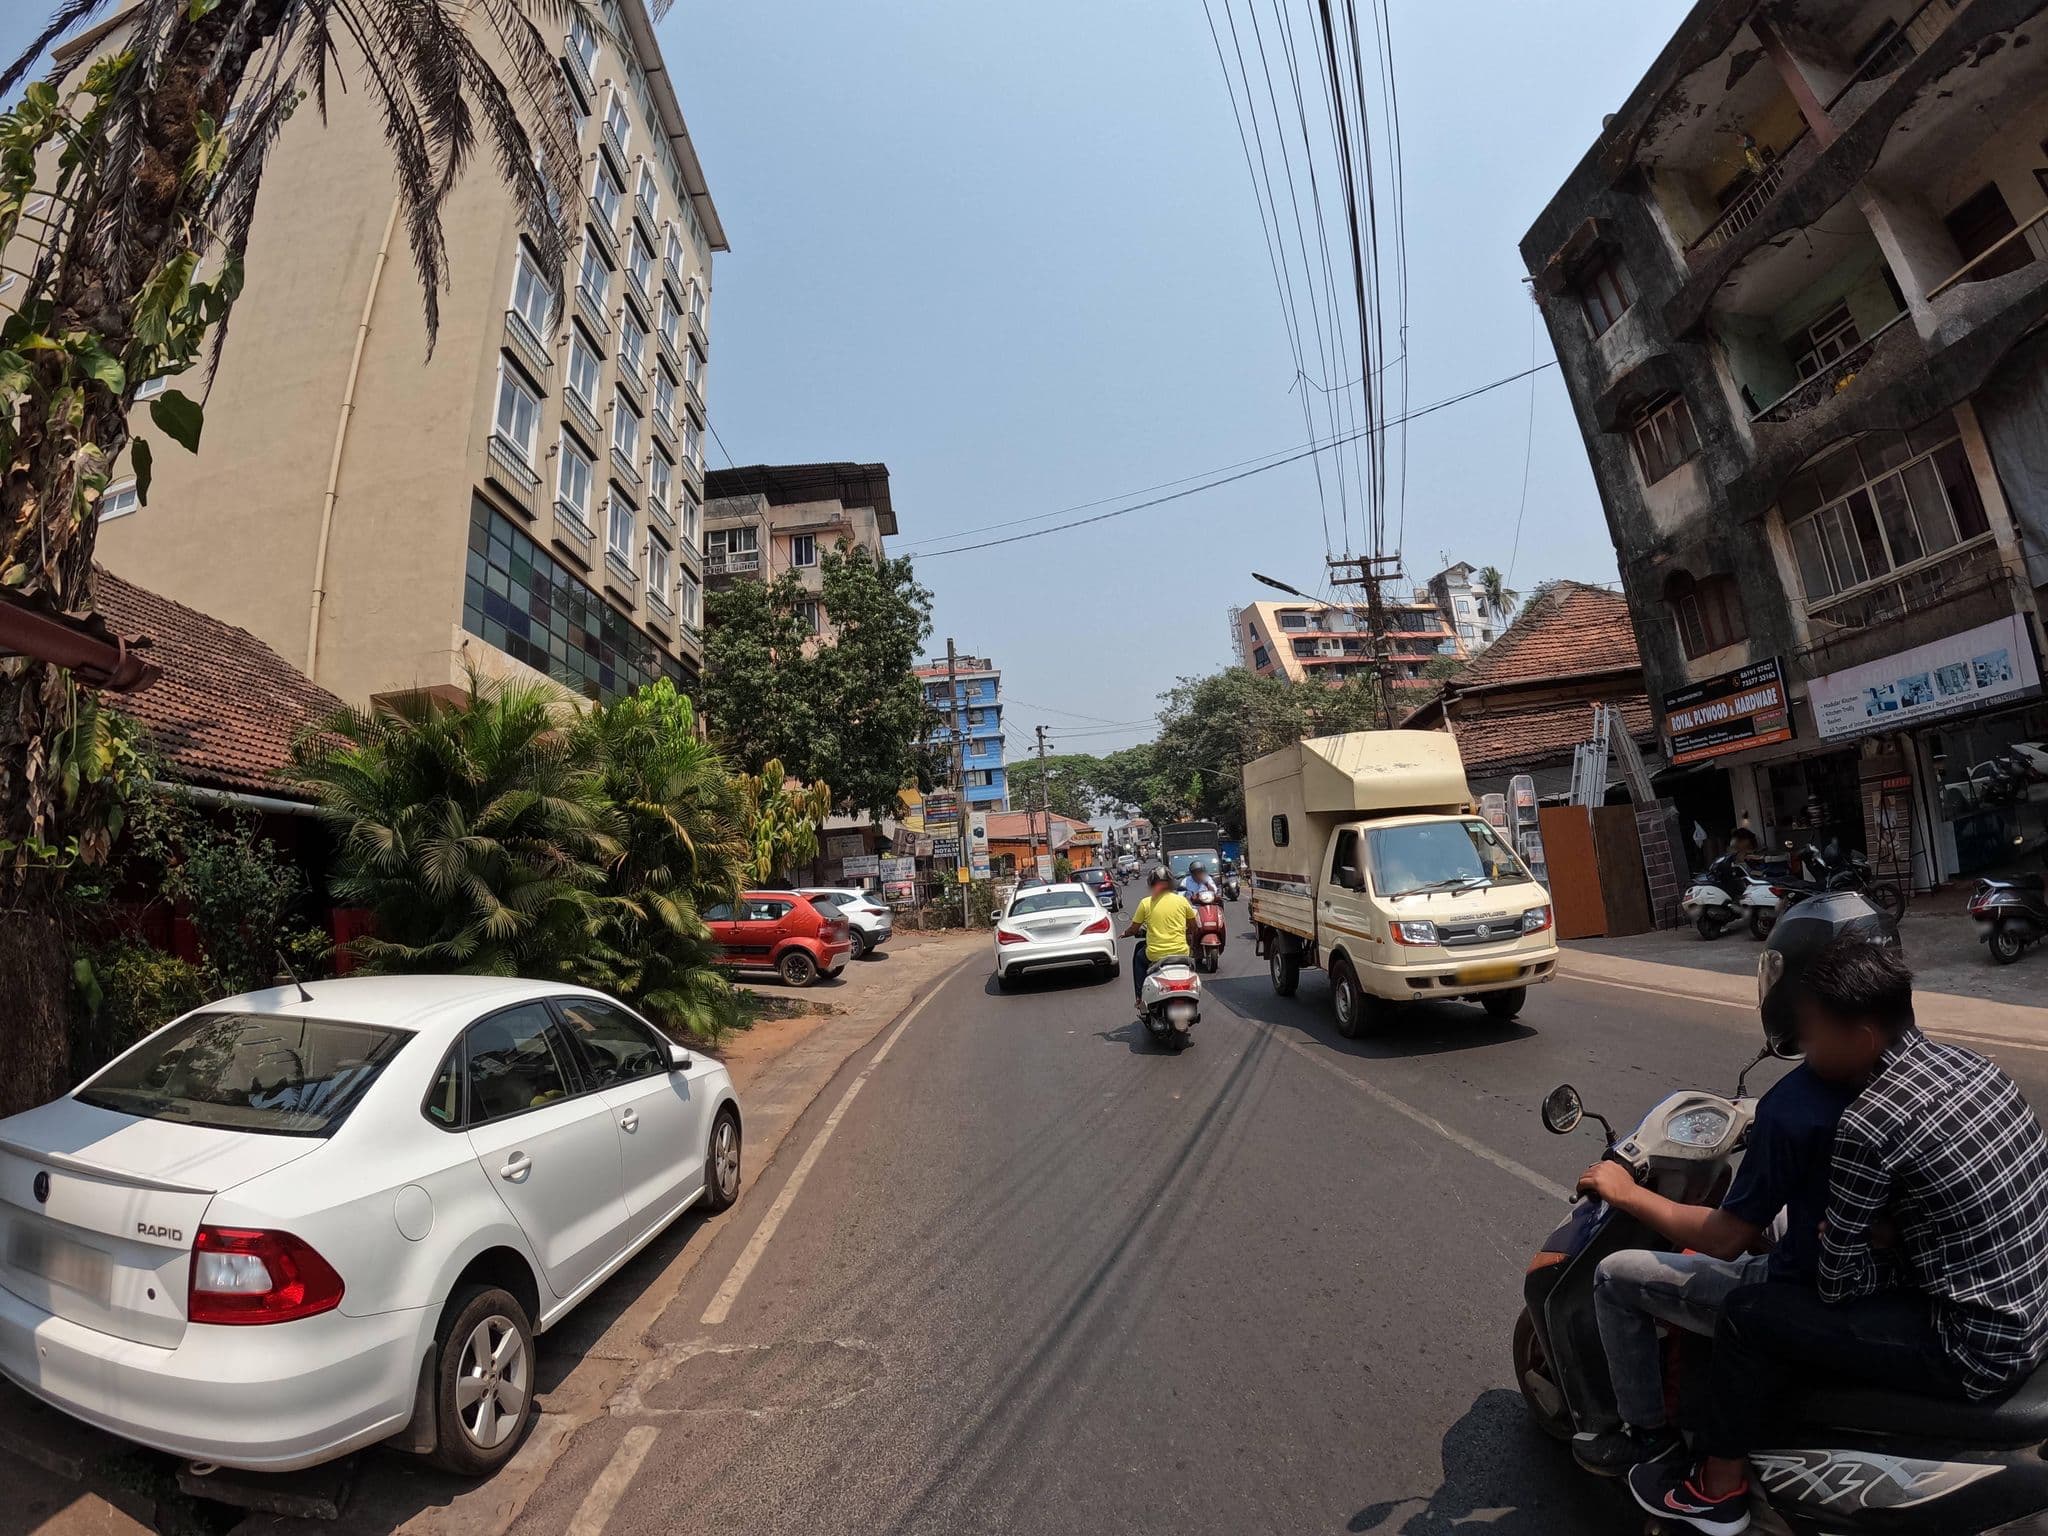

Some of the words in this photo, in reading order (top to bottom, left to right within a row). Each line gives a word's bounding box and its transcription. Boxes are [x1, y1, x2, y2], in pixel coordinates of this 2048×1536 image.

[1671, 712, 1694, 732] ROYAL
[1694, 702, 1728, 726] PLYWOOD
[1734, 687, 1778, 714] HARDWARE
[138, 1222, 182, 1241] RAPID
